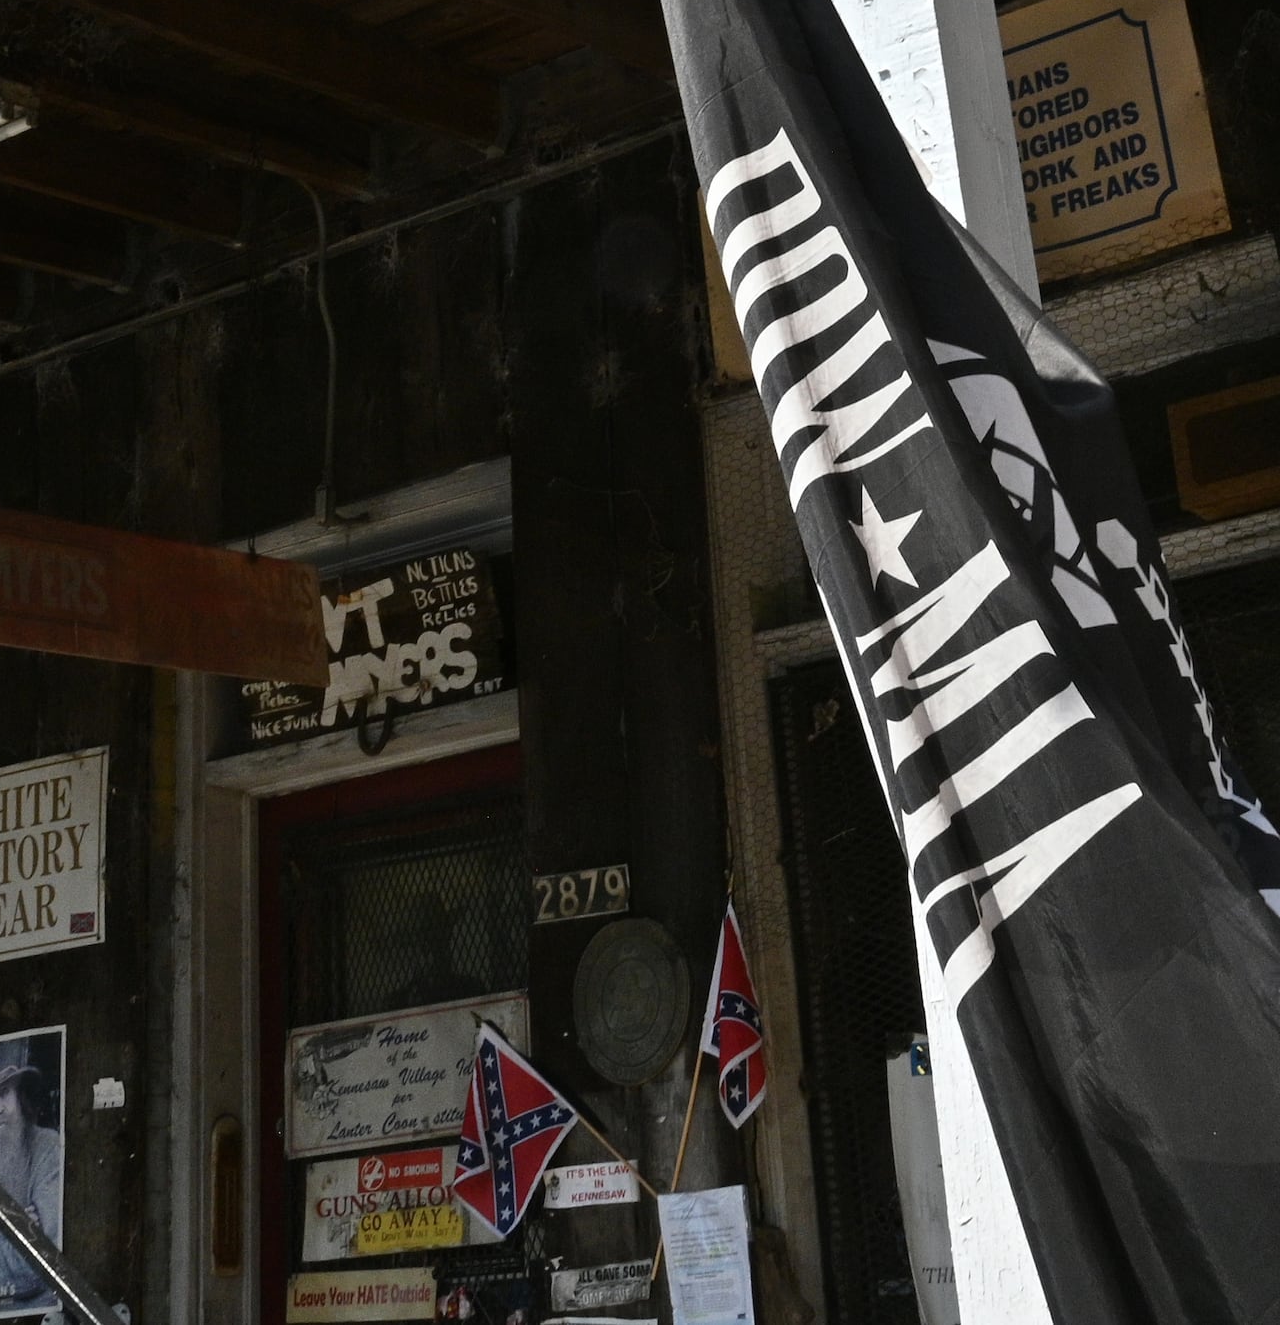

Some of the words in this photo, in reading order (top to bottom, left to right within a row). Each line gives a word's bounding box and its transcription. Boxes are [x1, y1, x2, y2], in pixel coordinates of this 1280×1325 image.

[1008, 61, 1071, 102] ANS
[1012, 87, 1090, 128] ORED
[1093, 133, 1147, 172] AND
[1051, 162, 1161, 218] FREAKS
[421, 602, 477, 628] RELICS
[319, 622, 478, 726] MYERS
[251, 720, 282, 740] NICE
[282, 712, 319, 732] JUNK
[855, 539, 1144, 1017] MIA
[535, 868, 627, 921] 2879
[377, 1026, 431, 1048] Home
[386, 1053, 398, 1067] of
[402, 1047, 419, 1061] the
[327, 1079, 391, 1097] Kennesaw
[399, 1067, 447, 1088] Village
[392, 1092, 414, 1108] per
[388, 1166, 401, 1179] NO
[404, 1162, 440, 1176] SMOKING
[566, 1168, 585, 1179] IT'S
[587, 1166, 606, 1177] THE
[571, 1189, 627, 1204] KENNESAW
[594, 1179, 604, 1189] IN
[316, 1192, 379, 1219] GUNS
[361, 1214, 382, 1232] GO
[389, 1207, 442, 1230] AWAY
[595, 1266, 621, 1282] GAVE
[293, 1286, 326, 1307] Leave
[328, 1286, 355, 1305] Your
[357, 1284, 389, 1305] HATE
[390, 1283, 432, 1304] Outside
